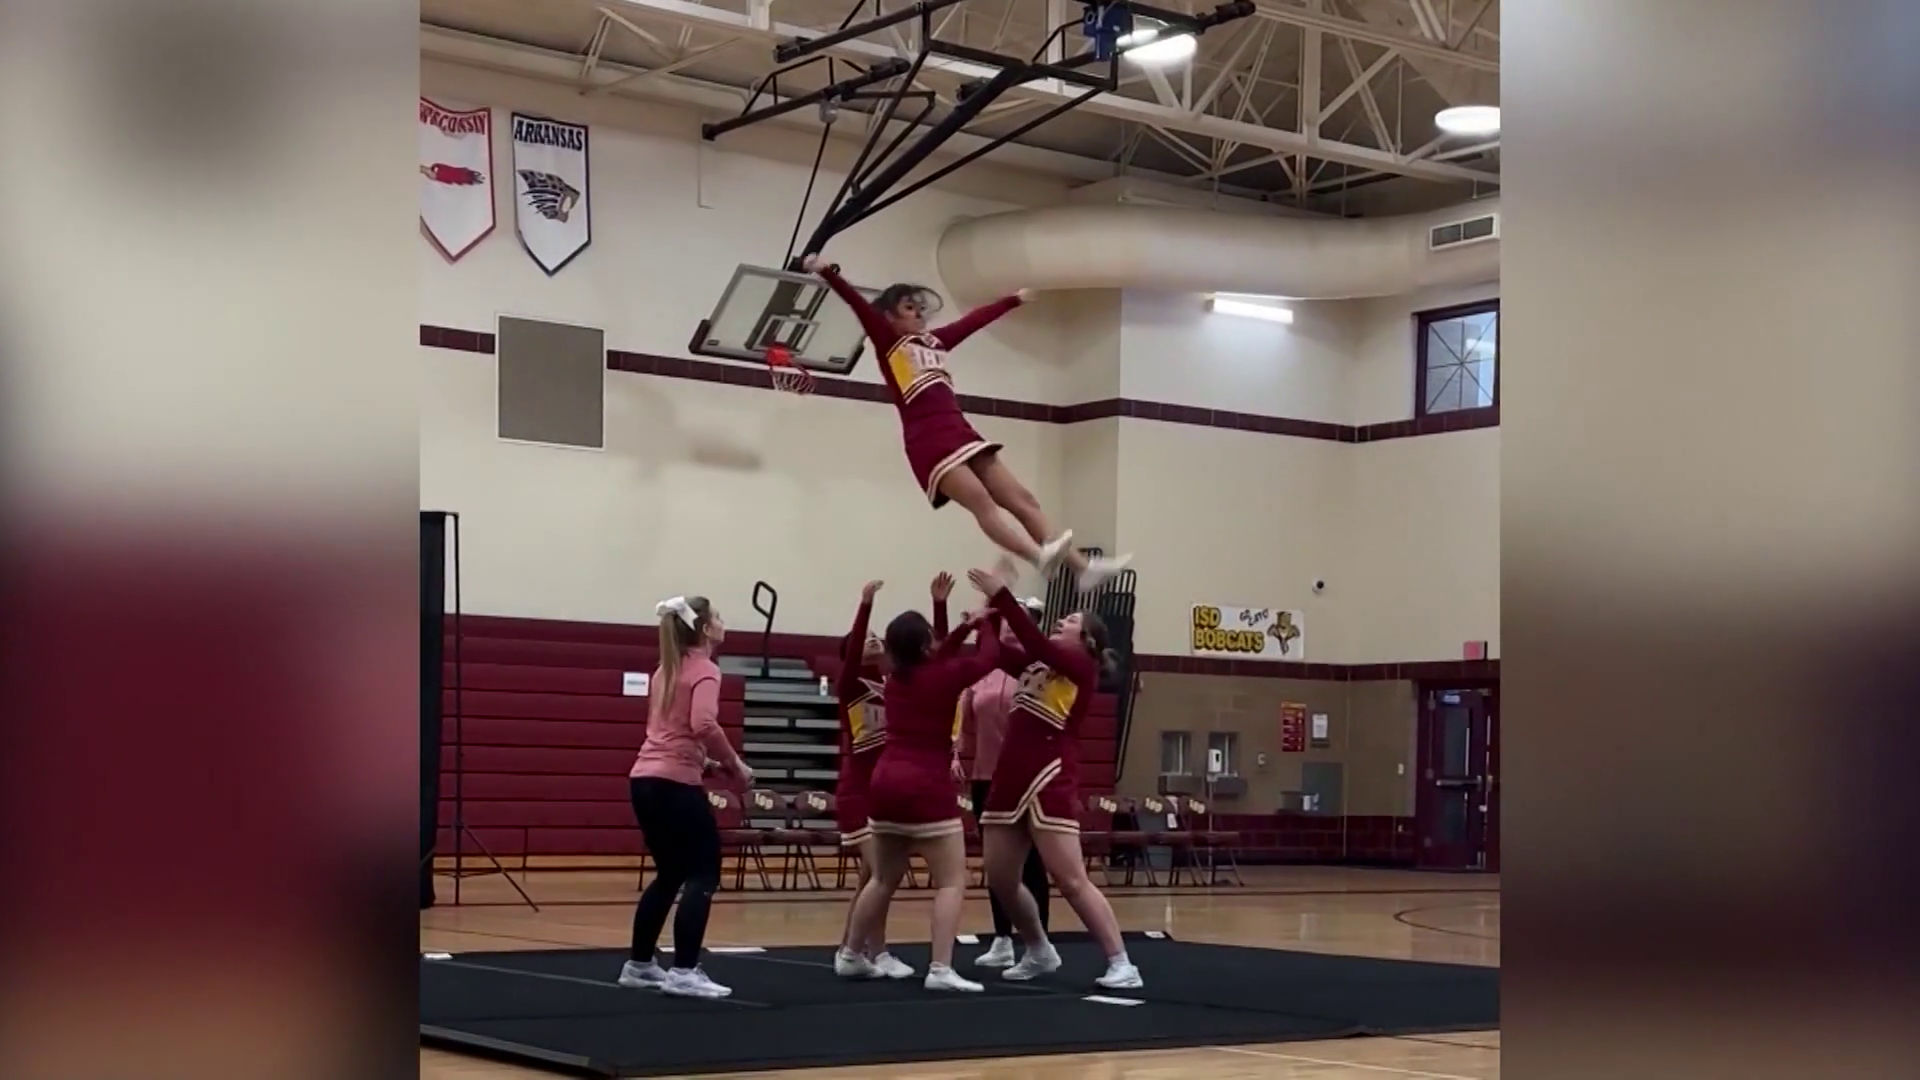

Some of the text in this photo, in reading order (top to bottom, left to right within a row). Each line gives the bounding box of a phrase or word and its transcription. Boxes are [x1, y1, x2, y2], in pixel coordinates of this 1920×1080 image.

[420, 102, 486, 135] SCONSIN
[514, 119, 583, 152] ARKANSAS
[1193, 605, 1222, 629] ISD
[1194, 629, 1265, 654] BOBCATS
